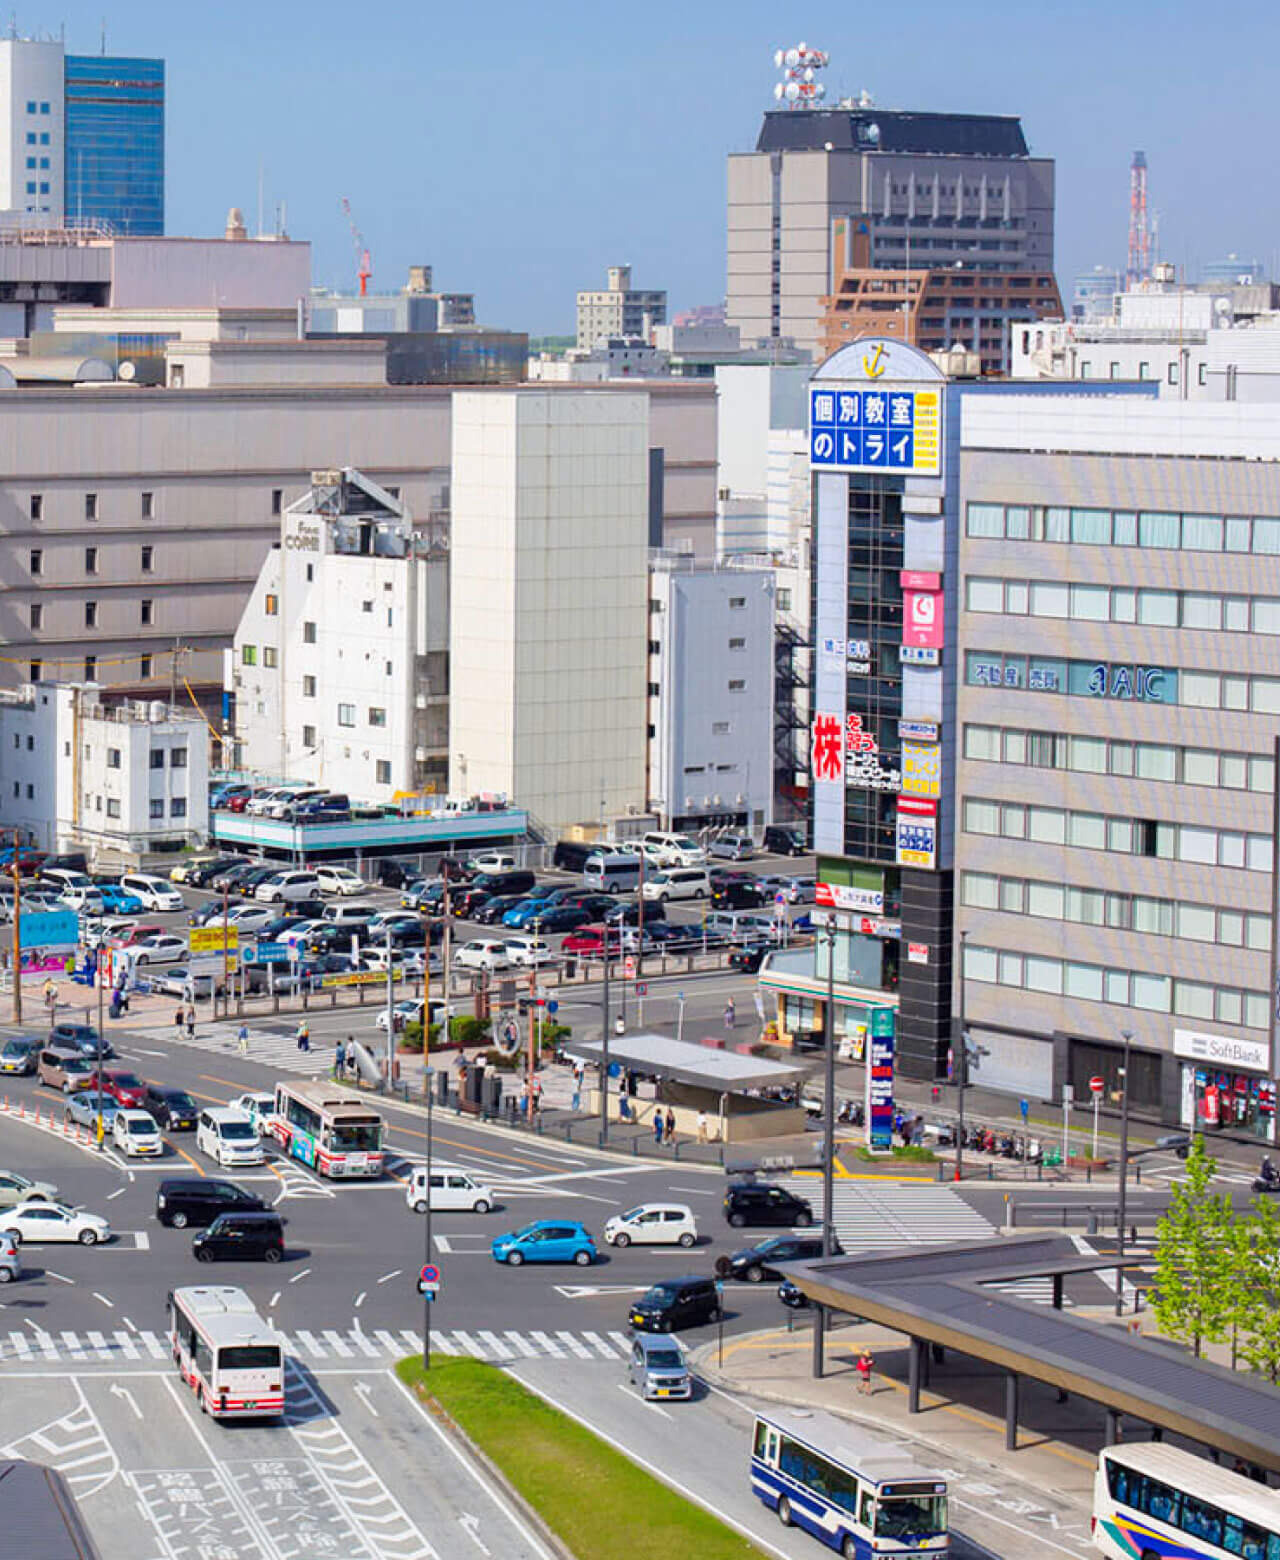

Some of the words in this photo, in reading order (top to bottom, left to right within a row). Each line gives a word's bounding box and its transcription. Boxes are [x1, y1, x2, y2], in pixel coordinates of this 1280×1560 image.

[814, 394, 912, 426] 個別教室
[813, 432, 910, 462] のトライ
[813, 713, 842, 780] 株
[1210, 1039, 1262, 1064] SoftBank
